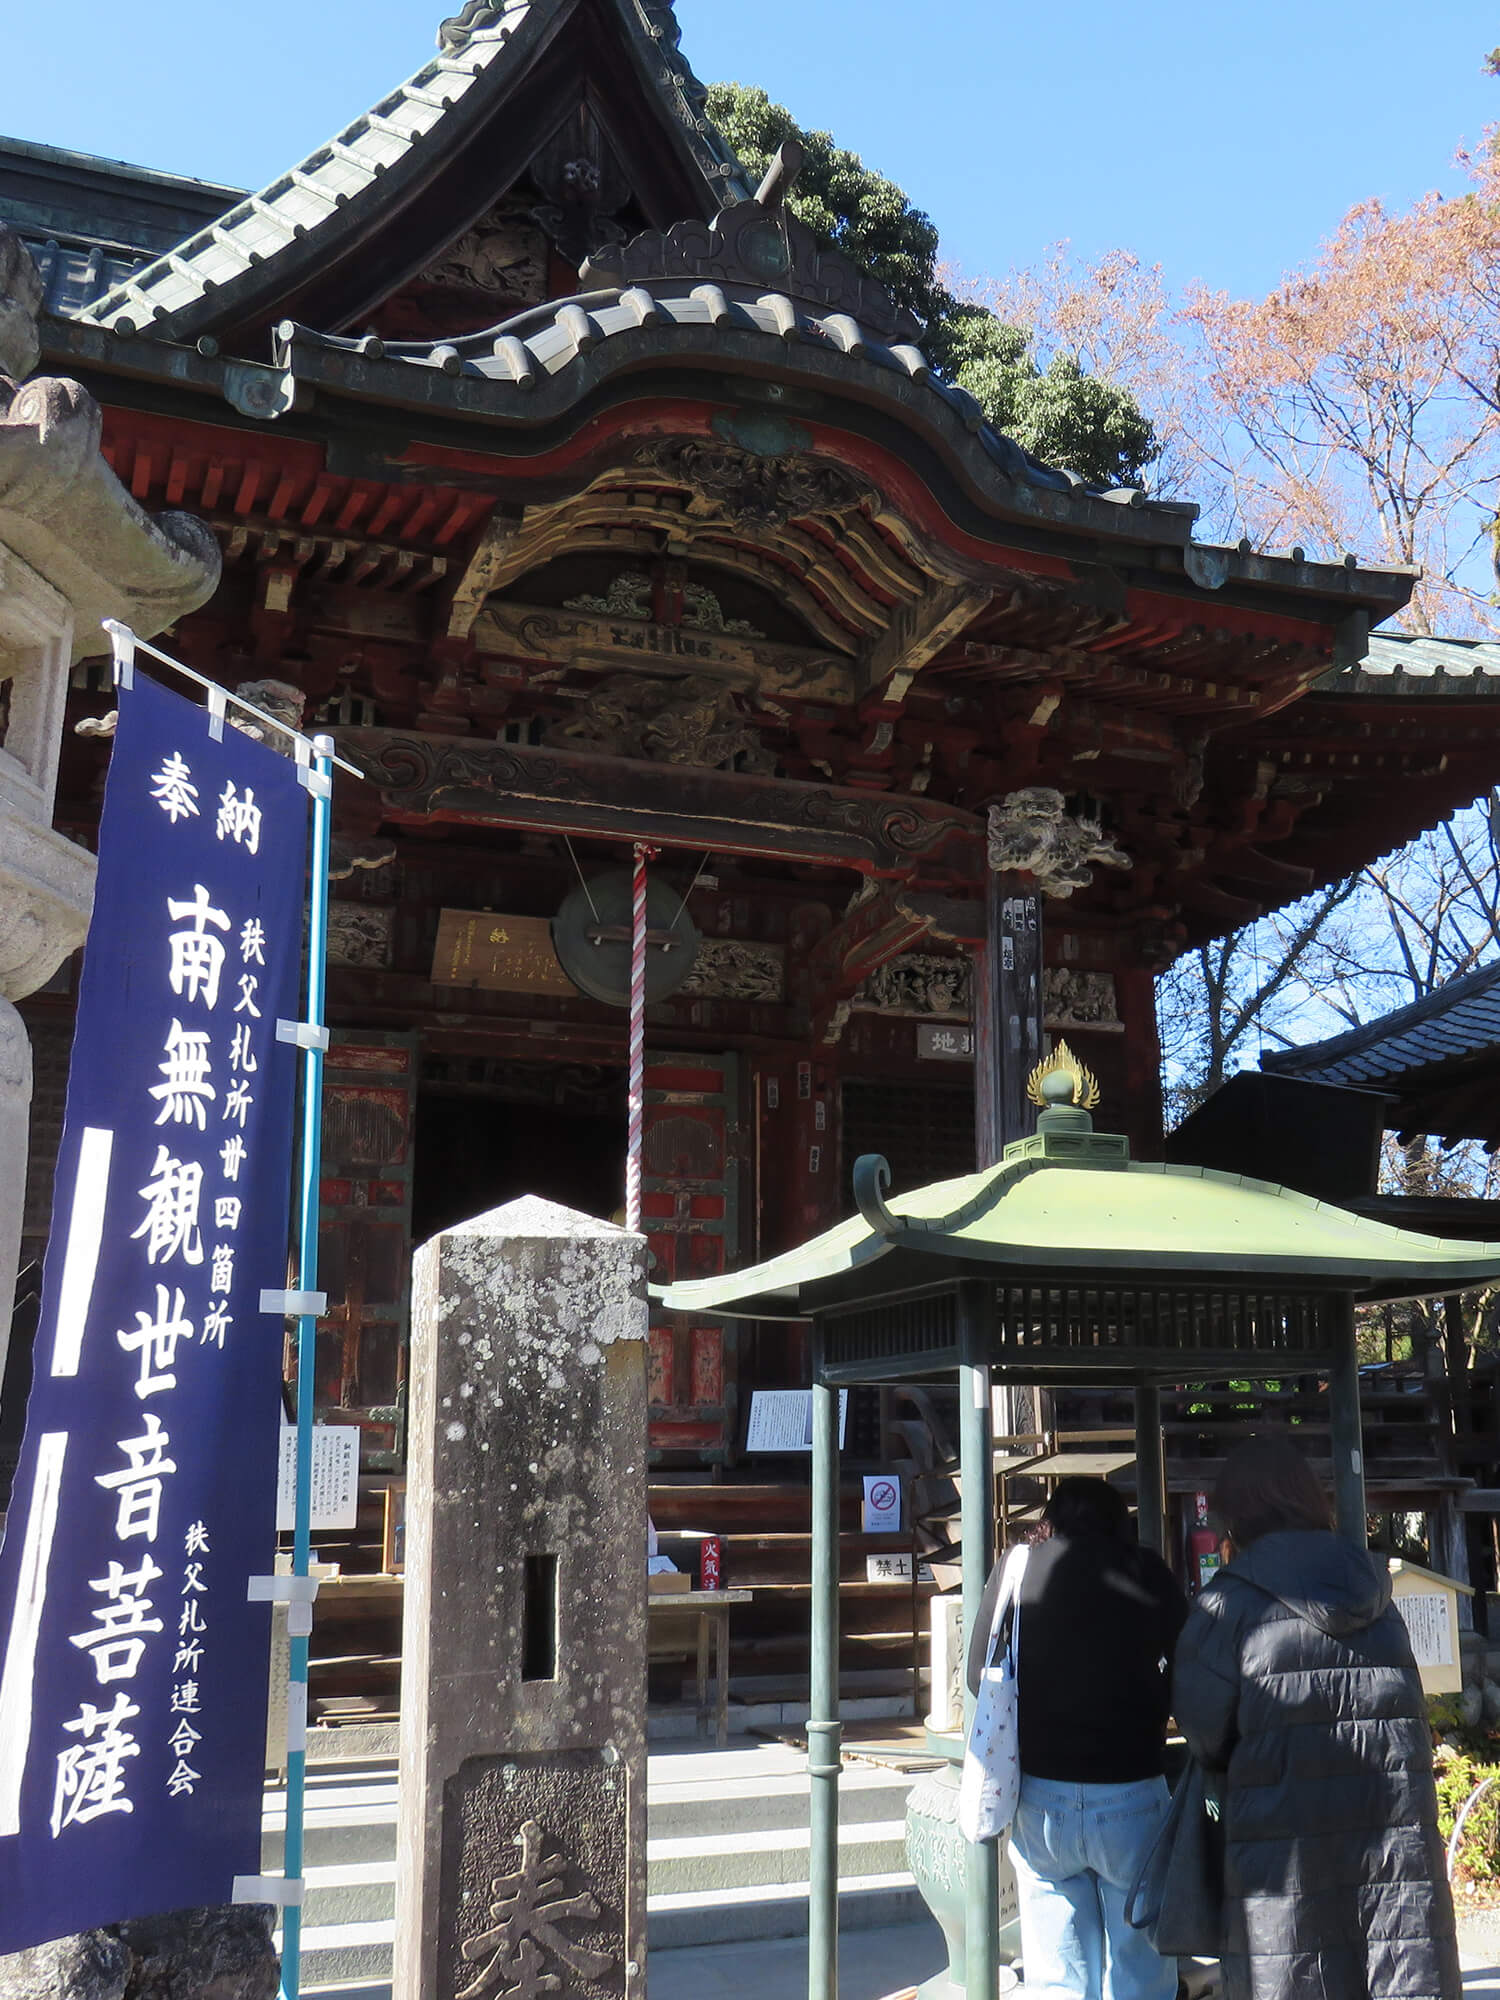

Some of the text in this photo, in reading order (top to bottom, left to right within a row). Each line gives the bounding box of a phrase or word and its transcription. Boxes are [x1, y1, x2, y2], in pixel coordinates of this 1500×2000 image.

[149, 751, 262, 855] 奉納
[166, 1521, 210, 1797] 秩父札所連合会
